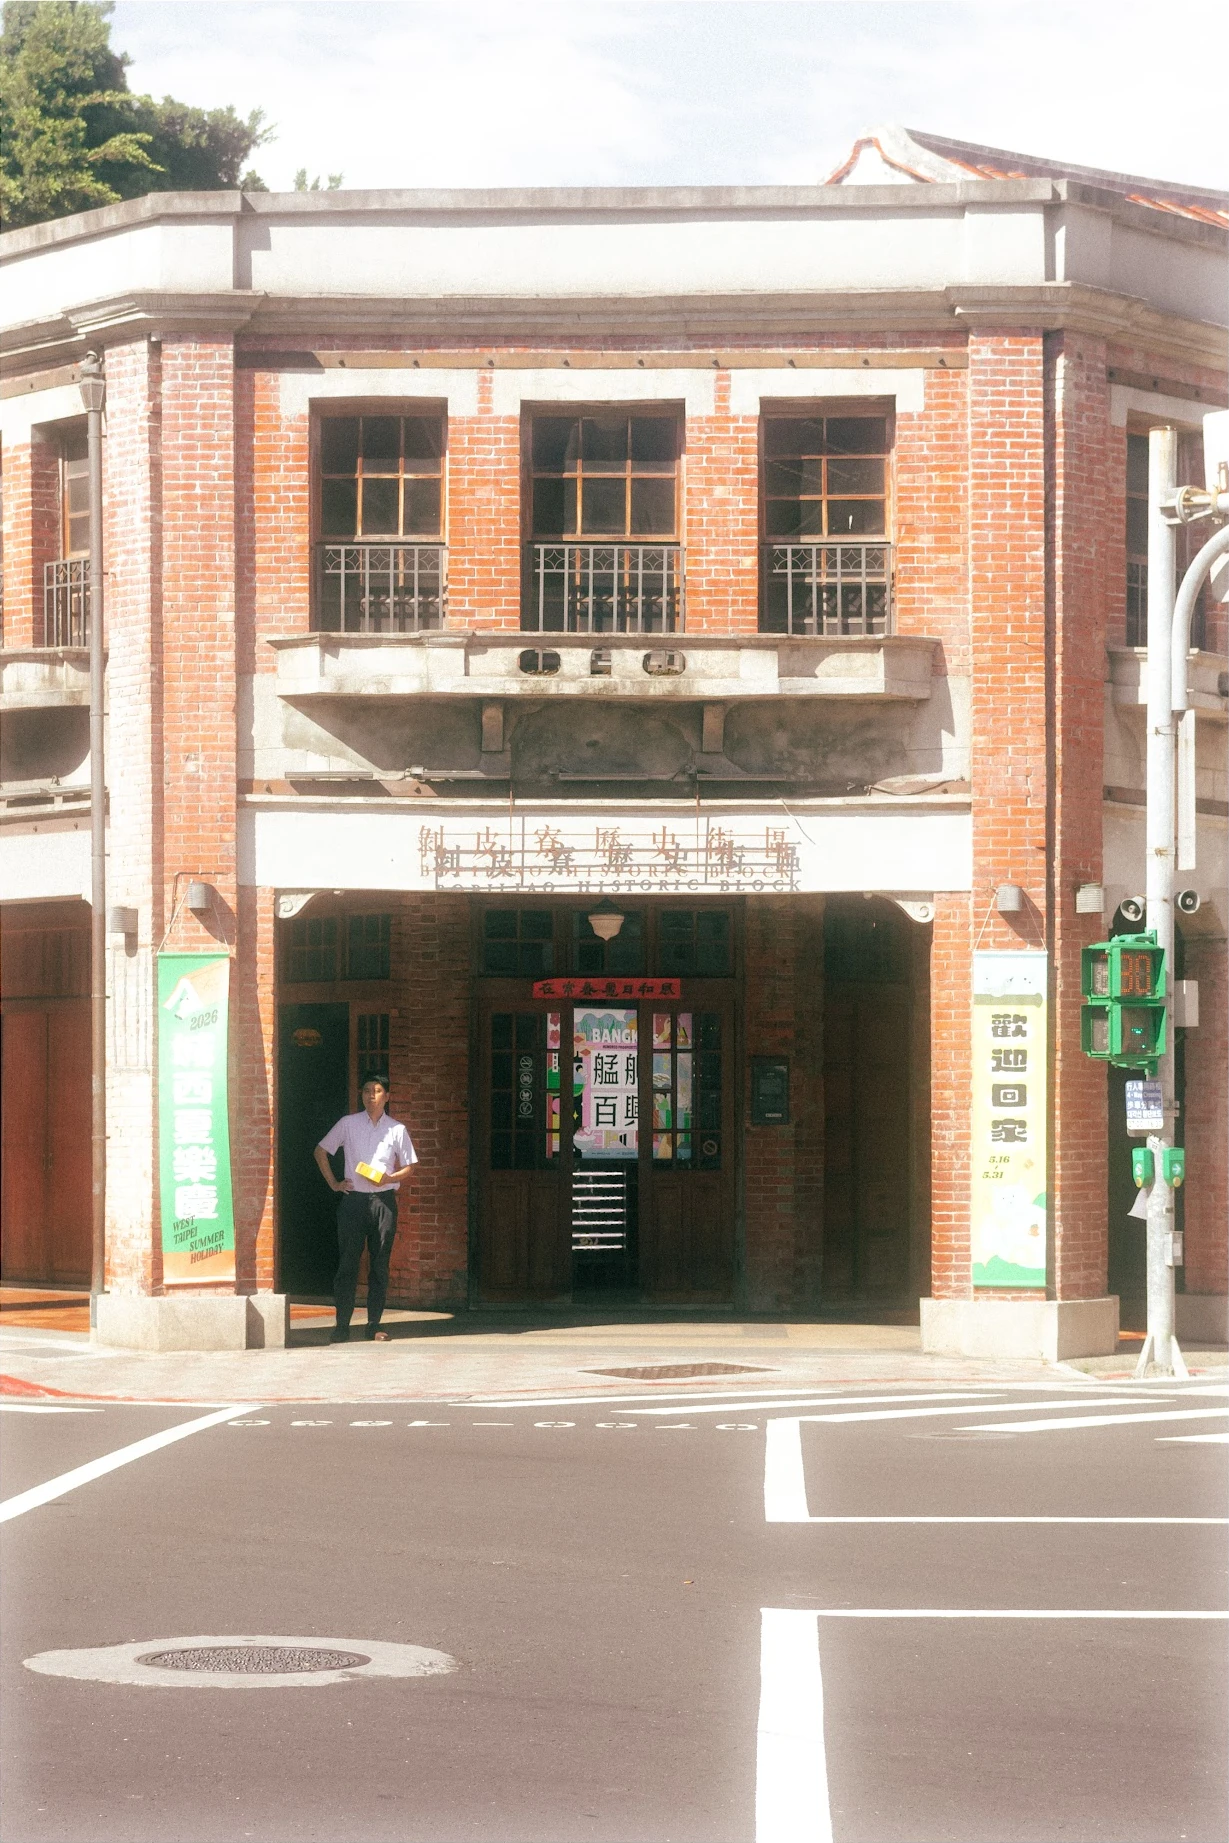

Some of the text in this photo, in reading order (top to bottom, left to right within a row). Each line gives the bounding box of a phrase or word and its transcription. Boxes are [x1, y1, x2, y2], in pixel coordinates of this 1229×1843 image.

[566, 865, 688, 878] HISTORIC
[710, 865, 790, 878] BLOCK
[189, 1009, 219, 1031] 2026
[991, 1013, 1028, 1143] 歡迎回家
[989, 1156, 1010, 1164] 5.16
[982, 1171, 1004, 1179] 5.31
[172, 1215, 196, 1233] WEST
[173, 1226, 198, 1245] TAIPEI
[189, 1230, 225, 1252] SUMMER
[190, 1243, 224, 1264] HOLIDAY
